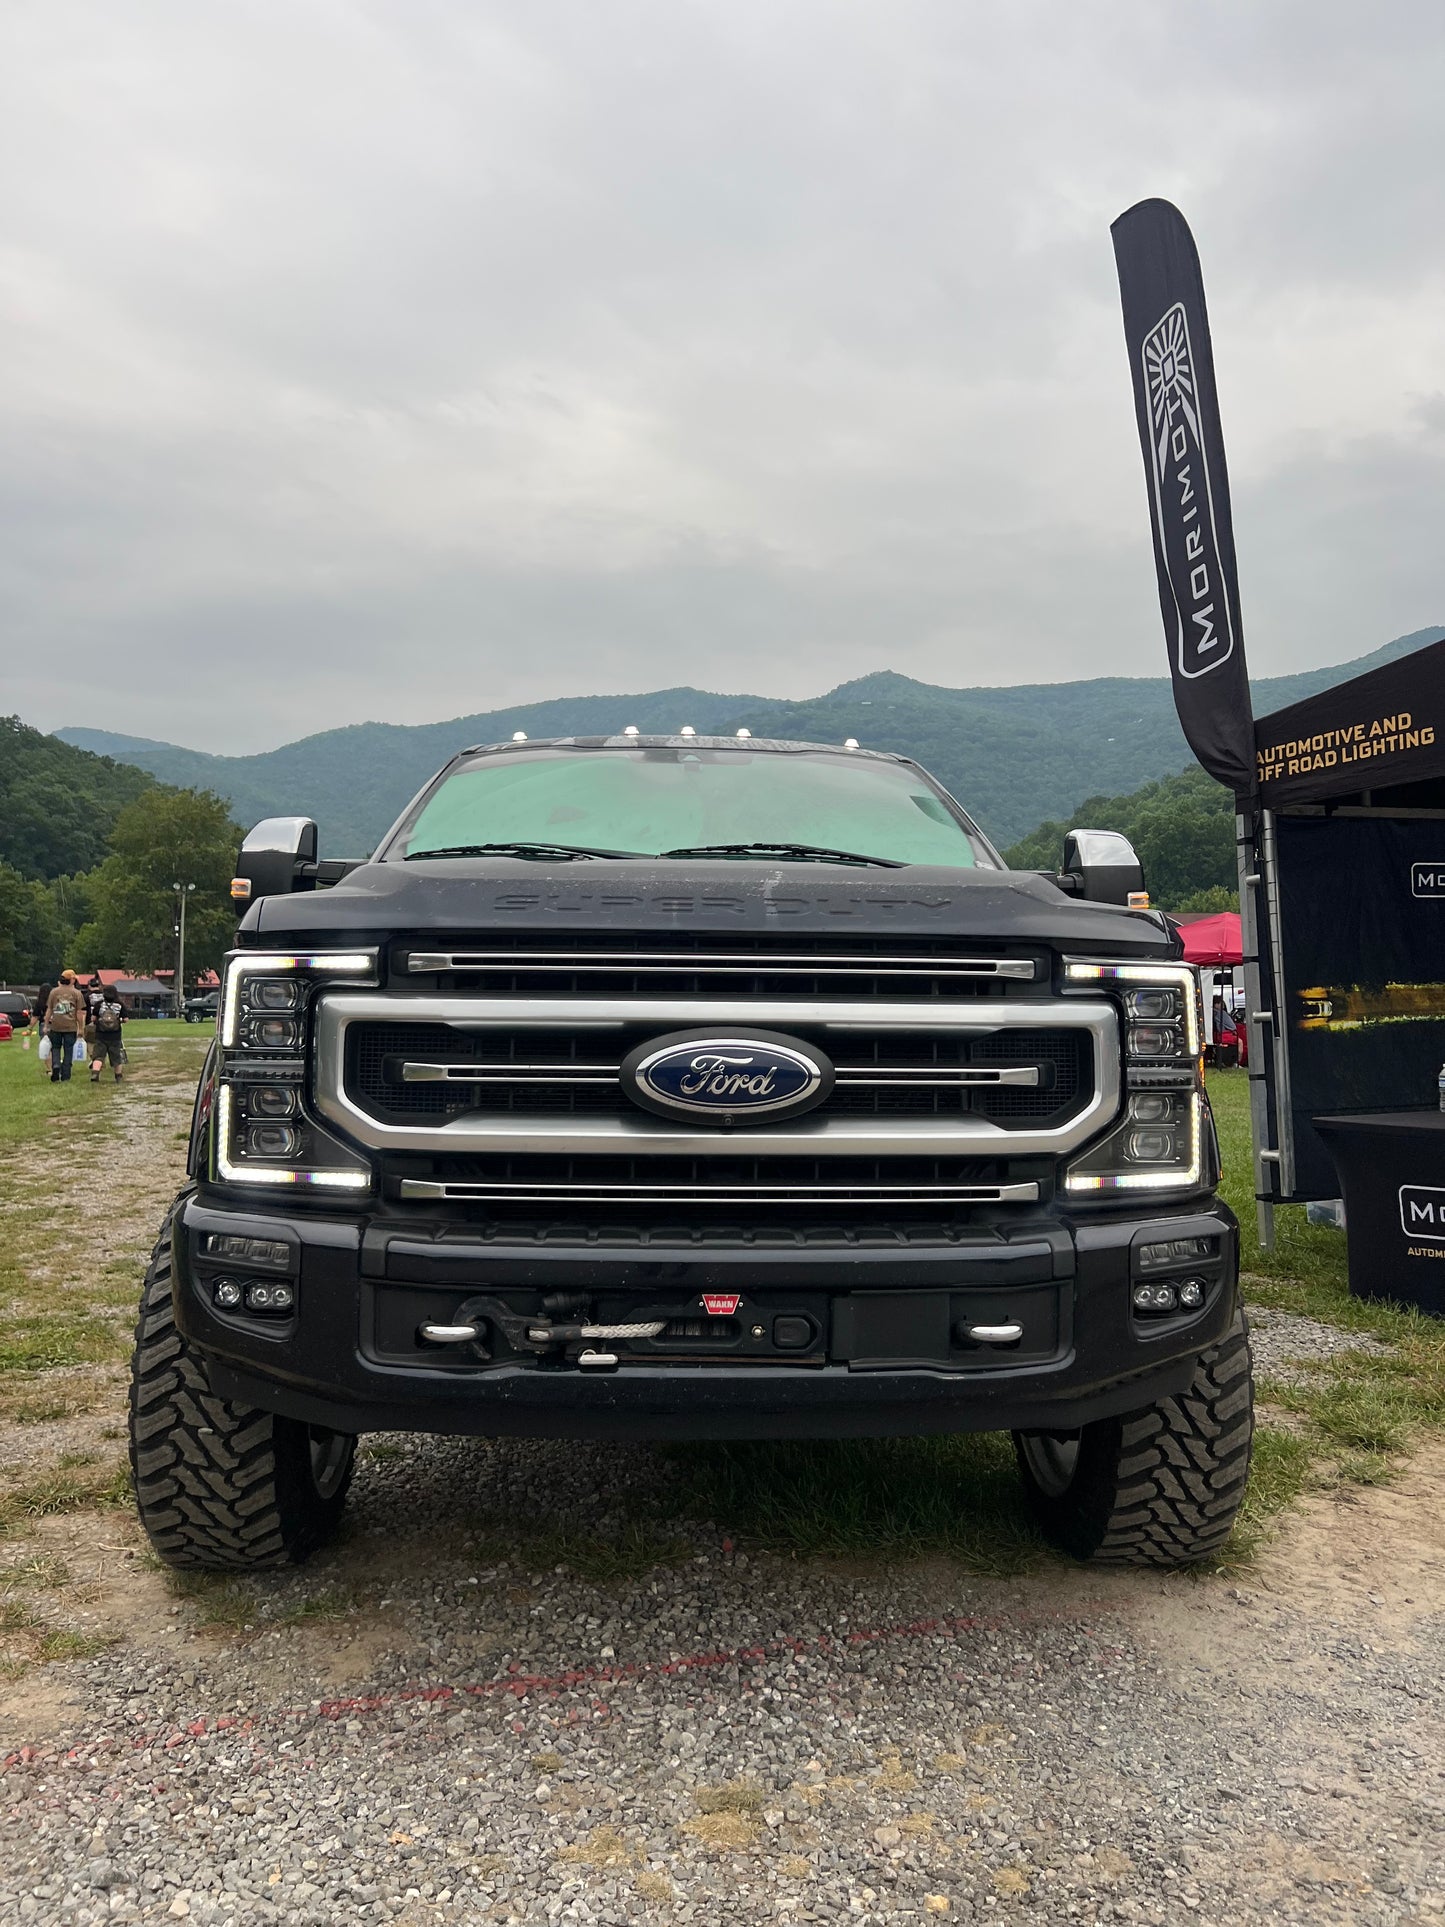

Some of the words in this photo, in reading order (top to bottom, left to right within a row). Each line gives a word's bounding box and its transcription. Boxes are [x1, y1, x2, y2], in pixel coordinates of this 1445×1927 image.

[1257, 724, 1365, 765] AUTOMOTIVE
[1369, 712, 1412, 738] AND
[1288, 750, 1337, 776] ROAD
[1342, 727, 1435, 764] LIGHTING
[494, 893, 746, 915] SUPER
[763, 896, 953, 919] DUTY
[680, 1054, 778, 1095] Ford
[708, 1300, 734, 1309] WARN
